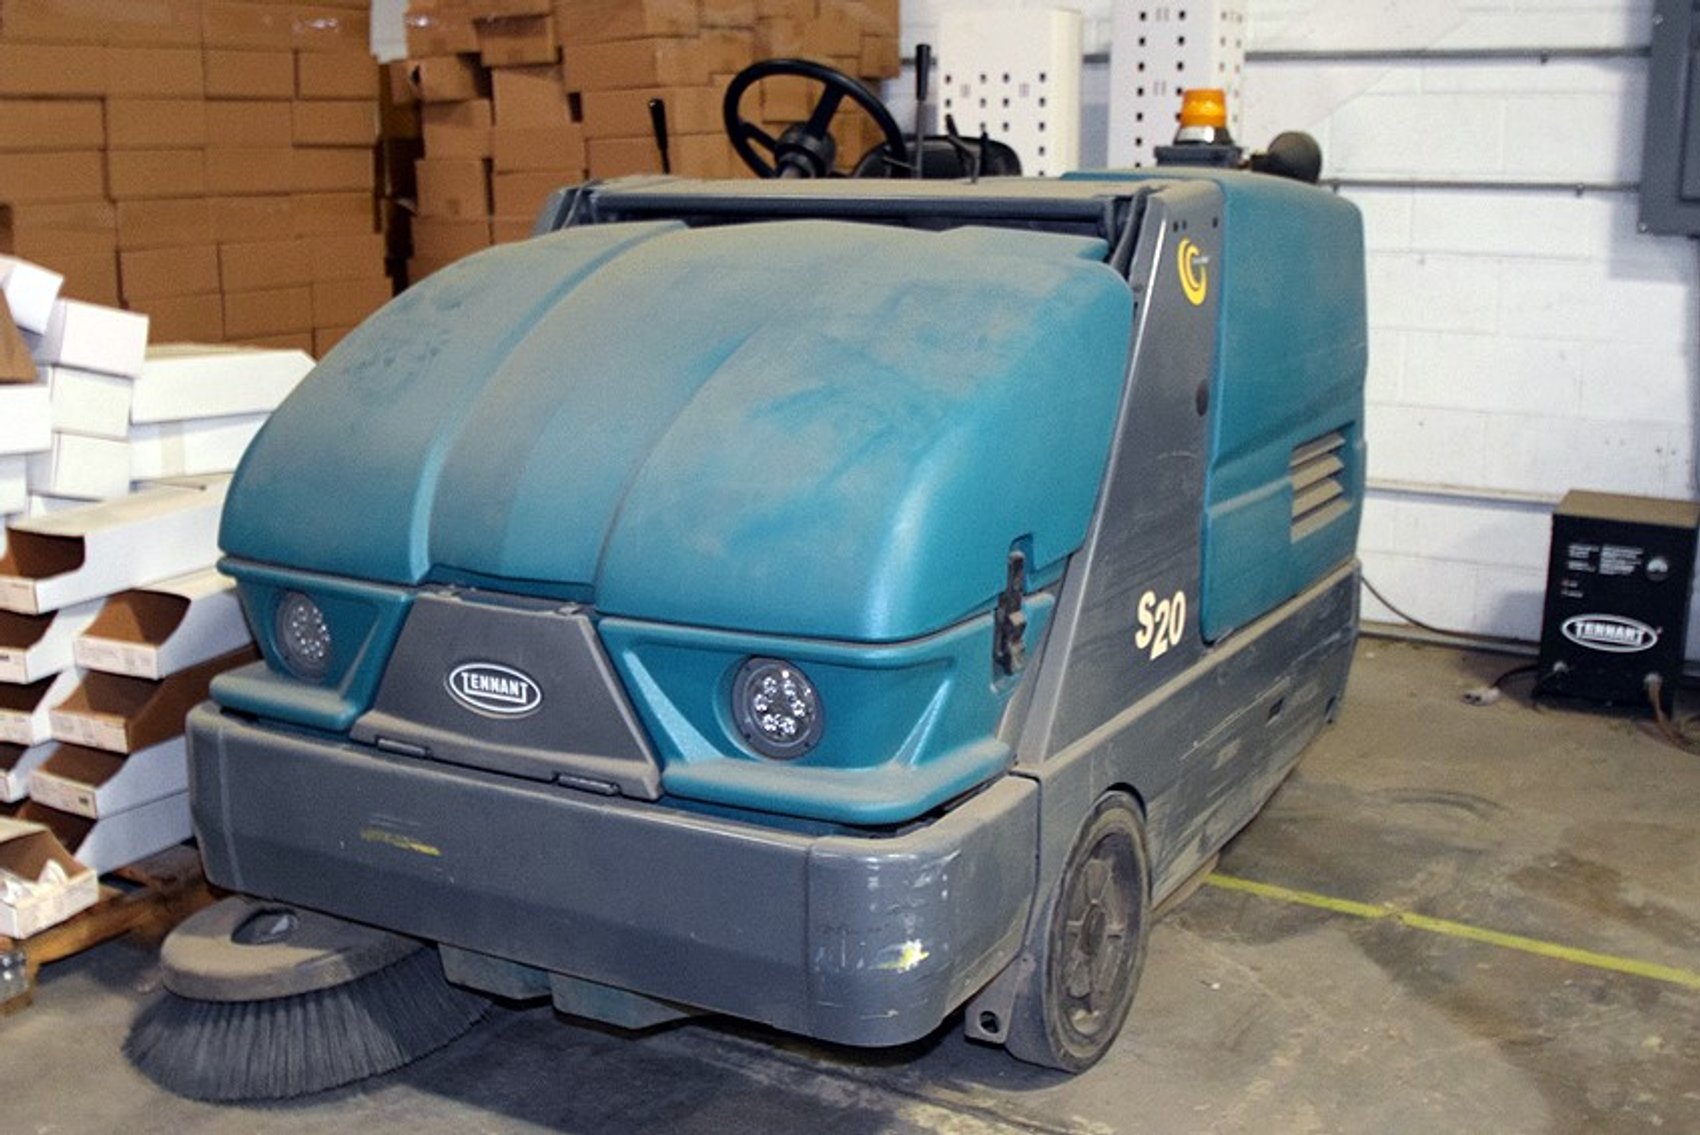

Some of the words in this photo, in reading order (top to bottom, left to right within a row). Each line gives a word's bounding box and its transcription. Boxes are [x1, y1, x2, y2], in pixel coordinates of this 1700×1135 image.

[1135, 590, 1187, 660] S20
[1575, 621, 1644, 645] TENNANT
[461, 671, 528, 704] TENNANT
